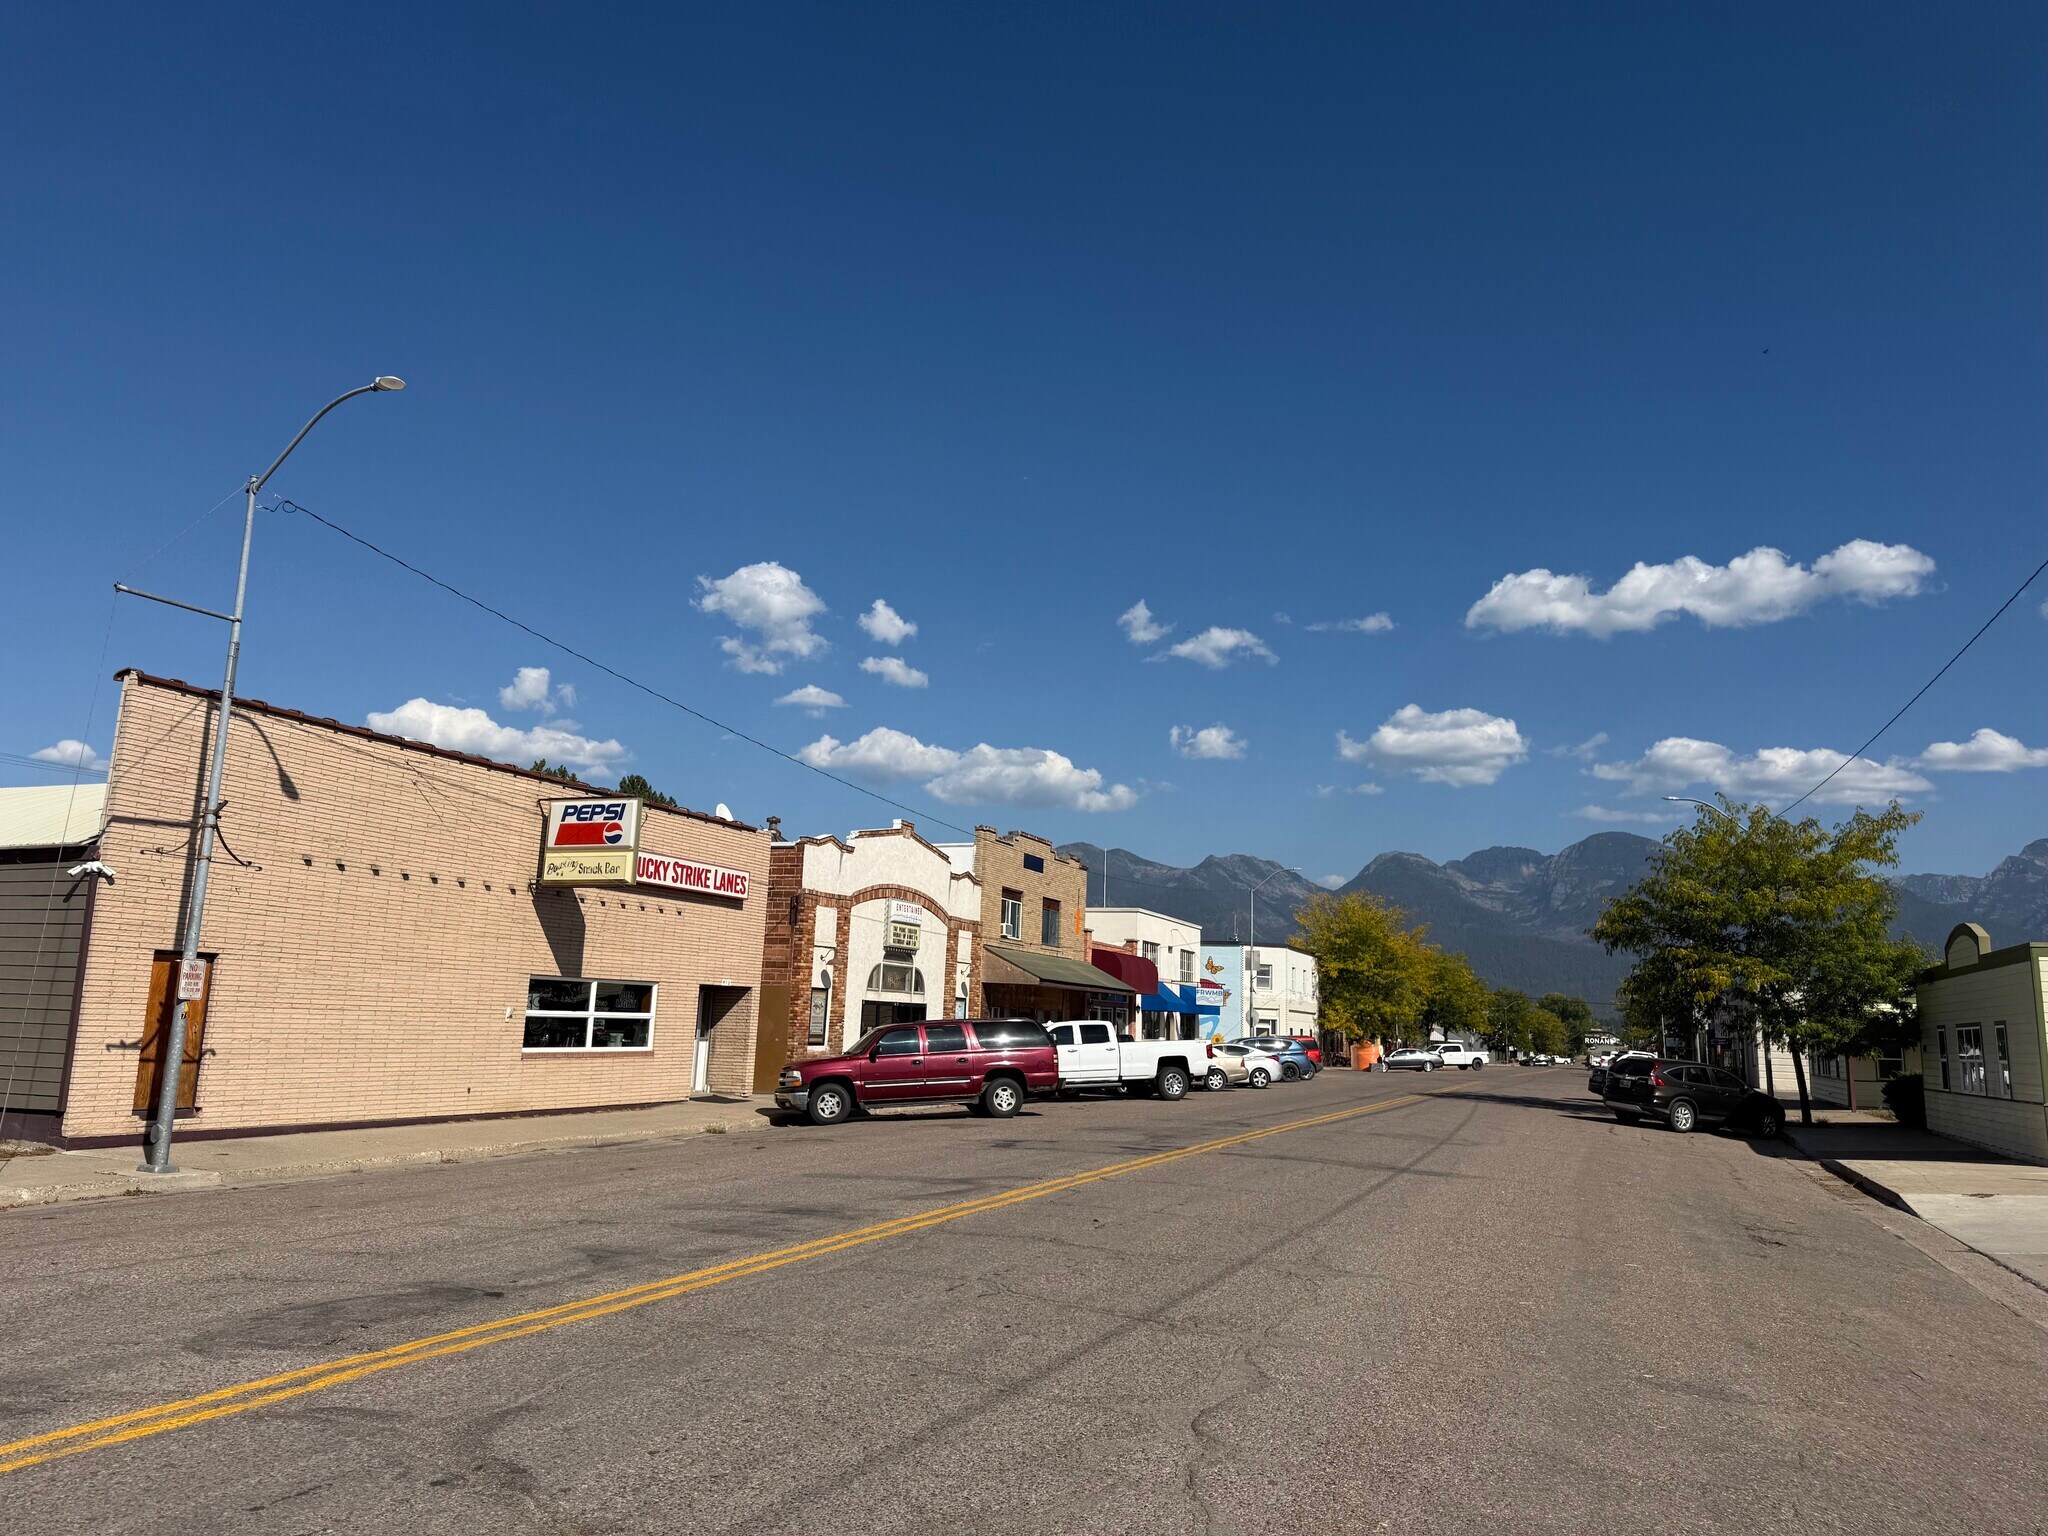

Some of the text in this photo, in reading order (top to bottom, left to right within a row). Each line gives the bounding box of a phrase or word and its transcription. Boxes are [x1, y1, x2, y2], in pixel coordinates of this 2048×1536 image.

[561, 803, 627, 822] PEPSI
[578, 862, 603, 875] Snack
[604, 861, 621, 875] Bar
[637, 856, 747, 895] UCKY STRIKE LANES
[896, 903, 923, 915] ENTERTAINER
[189, 964, 199, 972] NO
[183, 972, 202, 980] PARKING
